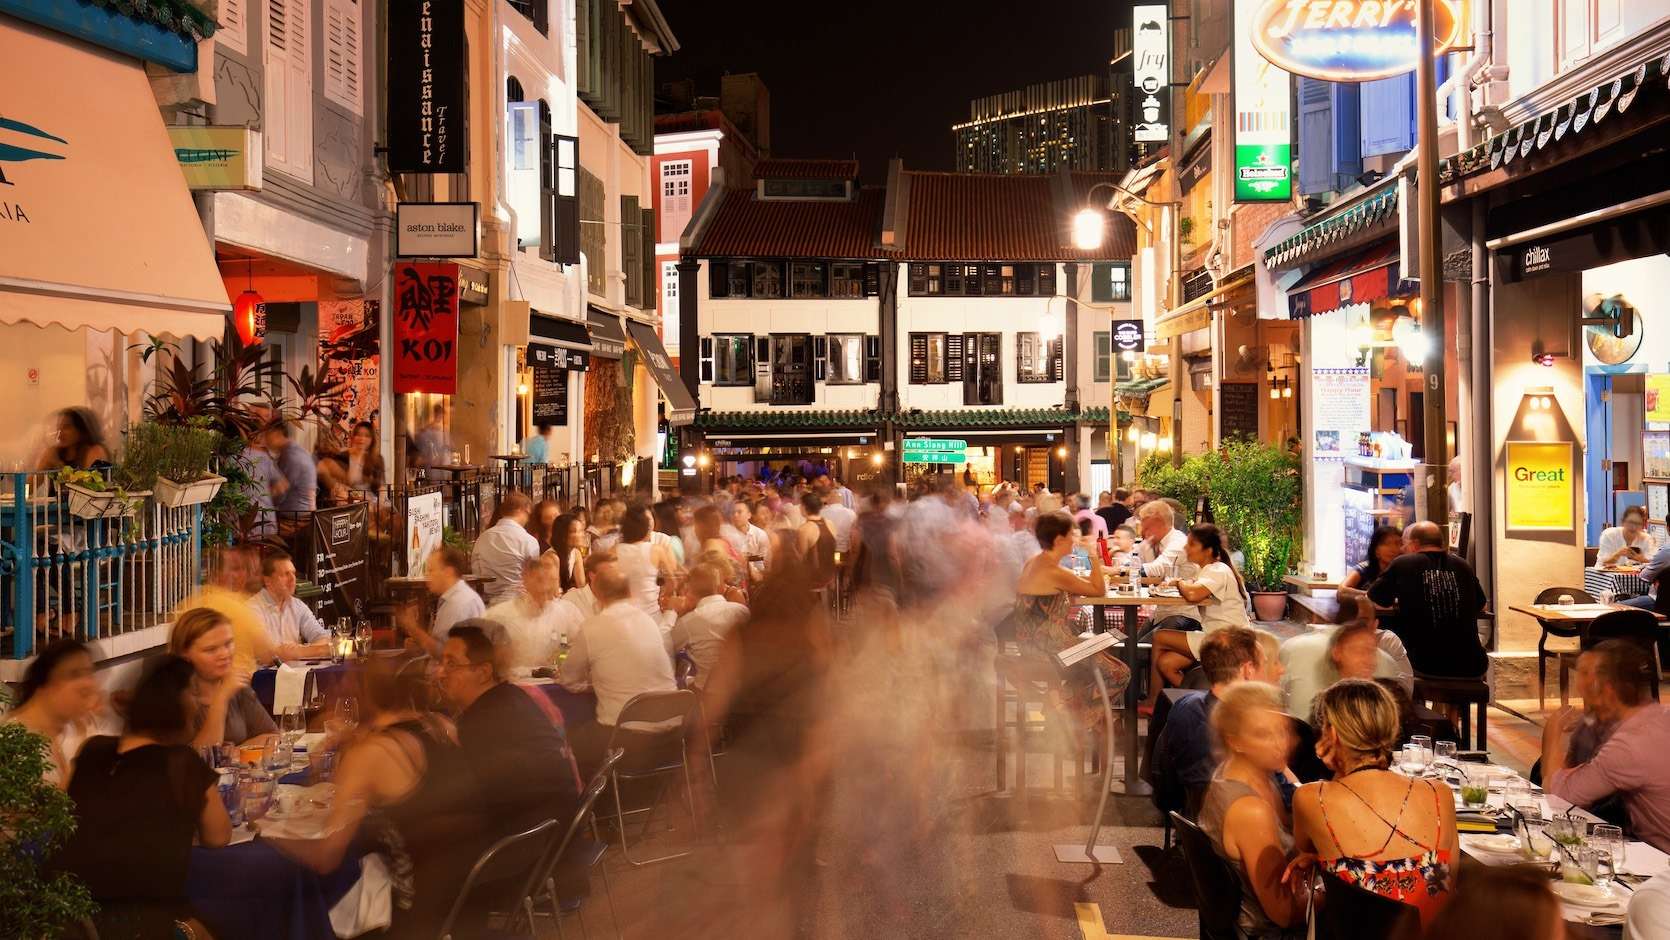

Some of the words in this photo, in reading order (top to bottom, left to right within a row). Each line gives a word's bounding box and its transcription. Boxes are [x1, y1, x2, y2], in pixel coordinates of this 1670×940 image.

[1136, 48, 1165, 71] fry
[436, 106, 447, 165] Travel
[407, 223, 435, 233] aston
[1525, 245, 1550, 266] chillax
[400, 339, 452, 362] KOI
[1430, 374, 1439, 390] 9
[905, 441, 922, 449] Ann
[948, 441, 963, 449] Hill
[1514, 466, 1565, 482] Great
